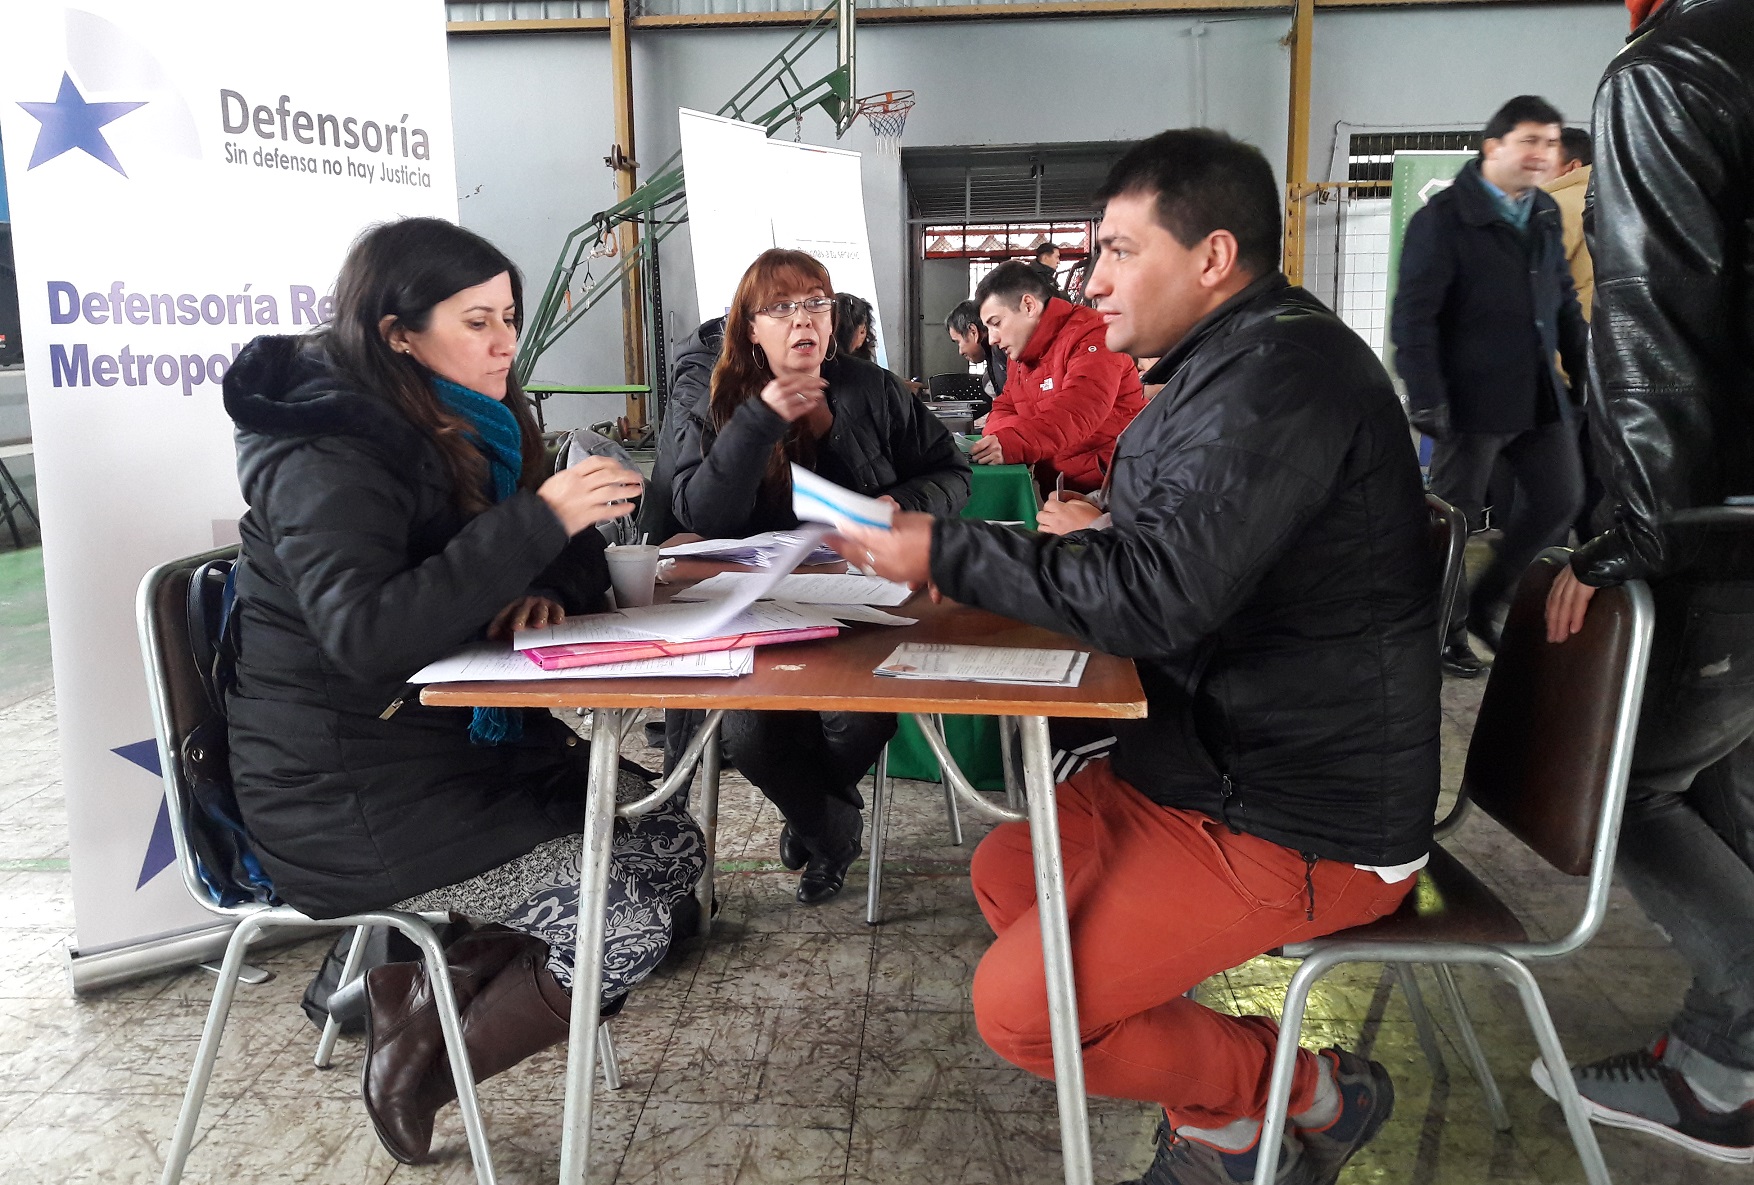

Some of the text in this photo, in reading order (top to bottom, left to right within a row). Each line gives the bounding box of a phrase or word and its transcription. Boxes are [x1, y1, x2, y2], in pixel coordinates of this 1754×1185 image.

[220, 88, 430, 160] Defensoría
[224, 141, 431, 188] Sin defensa no hay Justicia
[47, 280, 279, 325] Defensoría
[49, 343, 248, 396] Metropo
